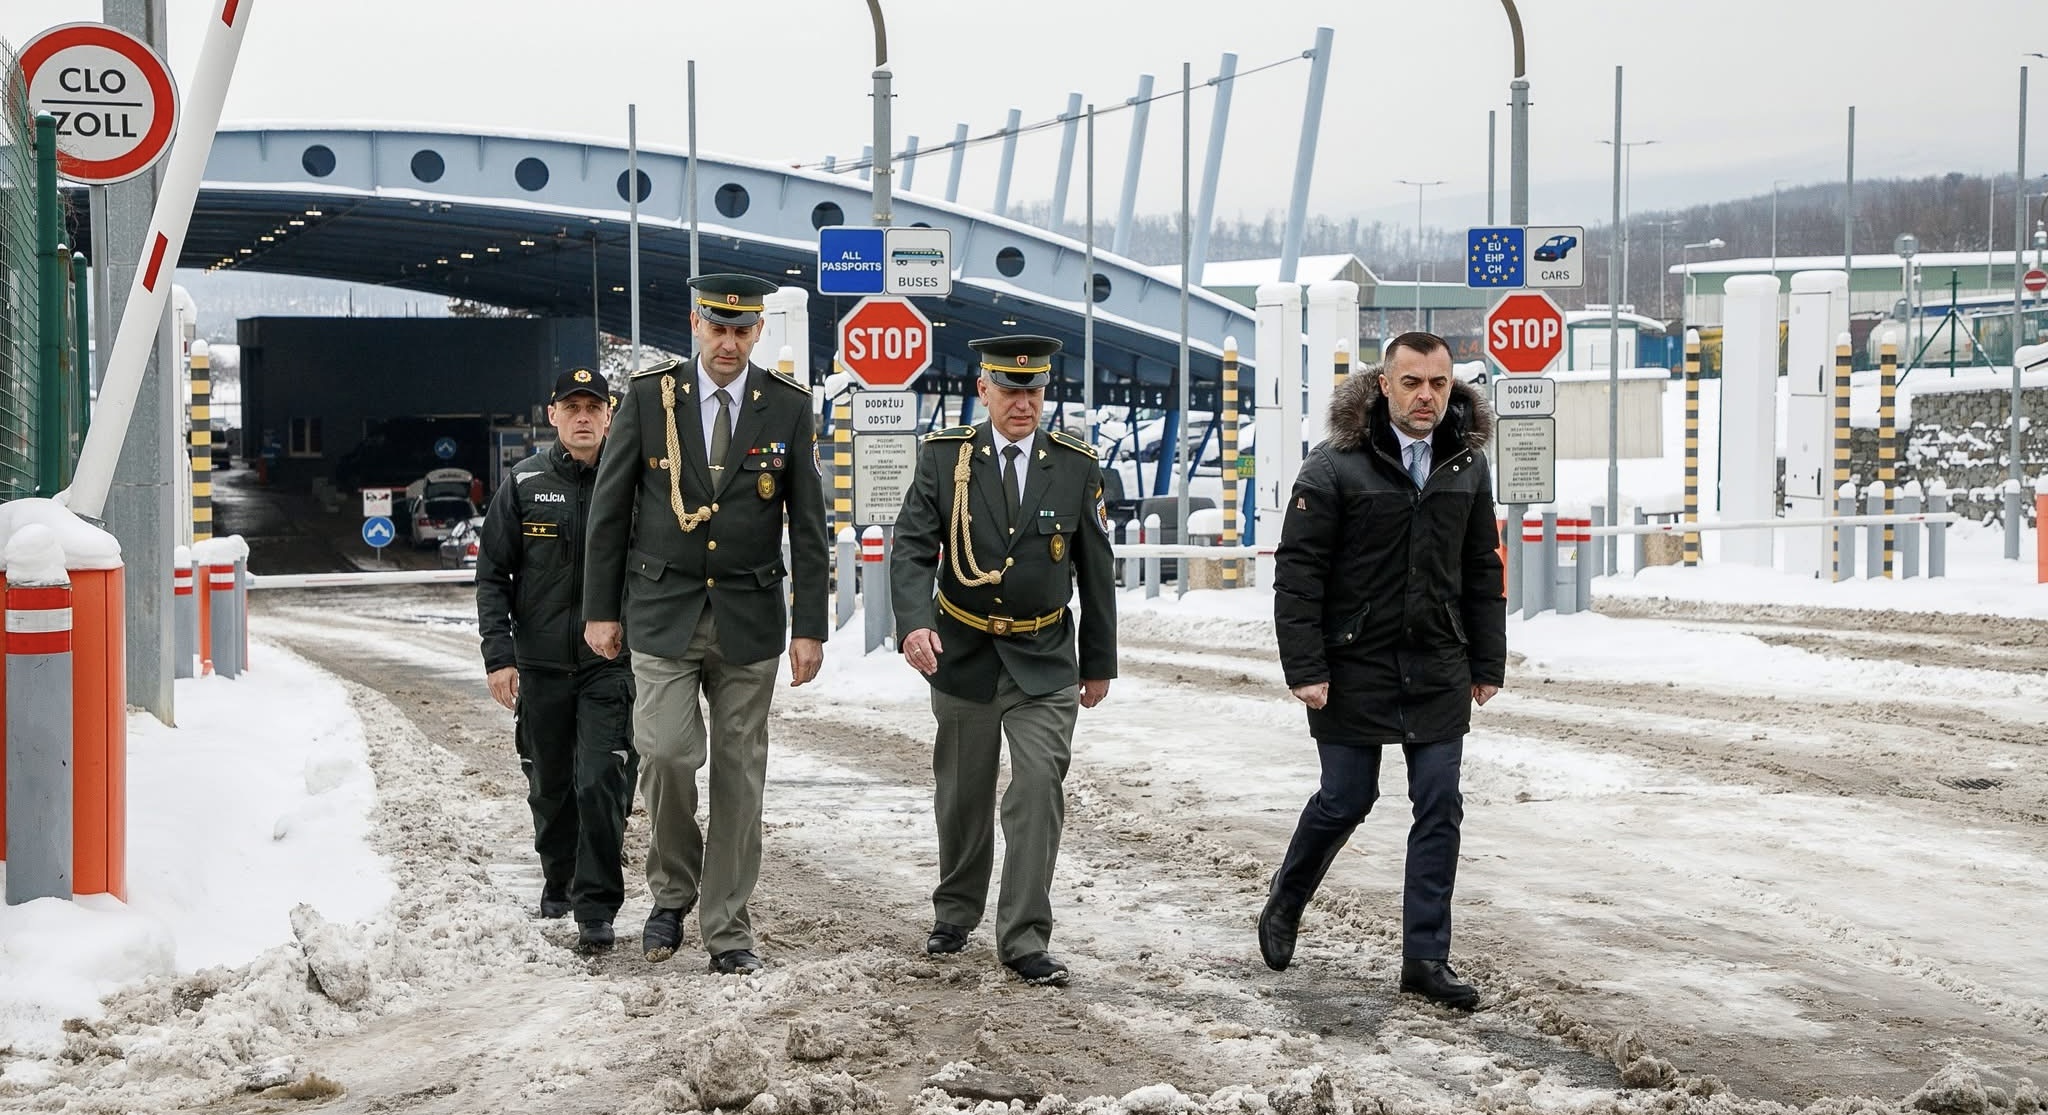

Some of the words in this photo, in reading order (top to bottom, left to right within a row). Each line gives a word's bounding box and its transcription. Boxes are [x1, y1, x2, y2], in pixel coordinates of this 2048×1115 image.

[59, 67, 126, 94] CLO
[50, 111, 137, 137] ZOLL
[1488, 241, 1501, 251] EÚ
[841, 251, 861, 260] ALL
[1485, 253, 1504, 262] EHP
[821, 262, 882, 271] PASSPORTS
[1488, 265, 1502, 273] CH
[1541, 271, 1570, 280] CARS
[898, 277, 938, 287] BUSES
[1492, 318, 1558, 350] STOP
[848, 327, 922, 360] STOP
[1507, 384, 1543, 394] DODRŽUJ
[865, 397, 904, 408] DODRŽUJ
[1510, 401, 1540, 409] ODSTUP
[868, 416, 901, 424] ODSTUP
[534, 491, 566, 502] POLÍCIA
